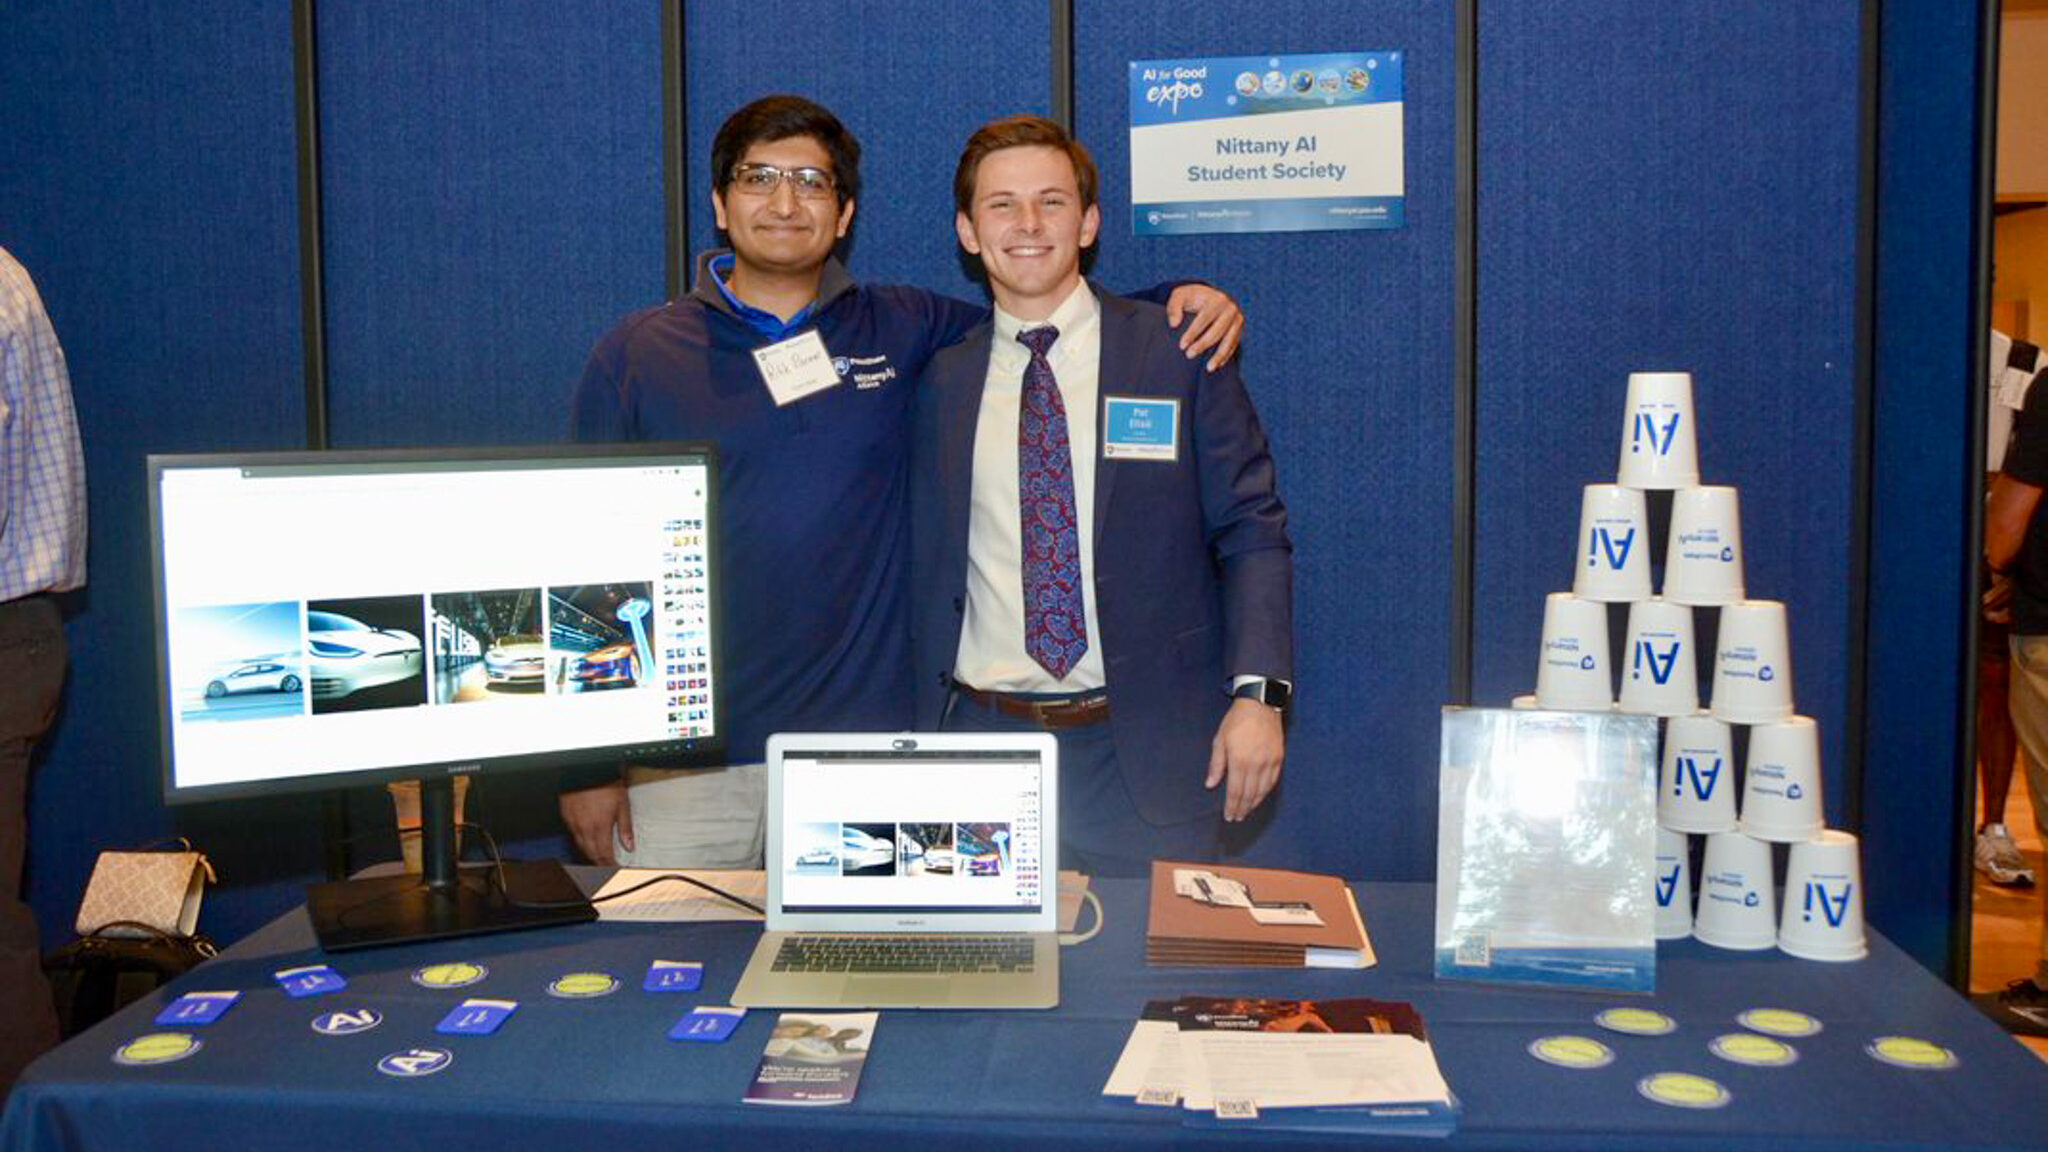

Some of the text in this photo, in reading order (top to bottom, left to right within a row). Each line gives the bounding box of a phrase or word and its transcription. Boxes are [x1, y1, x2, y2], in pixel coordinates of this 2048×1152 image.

[1143, 69, 1156, 81] AI
[1174, 66, 1207, 79] Good
[1147, 81, 1203, 115] expo
[1216, 136, 1316, 156] Nittany AI
[1188, 162, 1346, 182] Student Society
